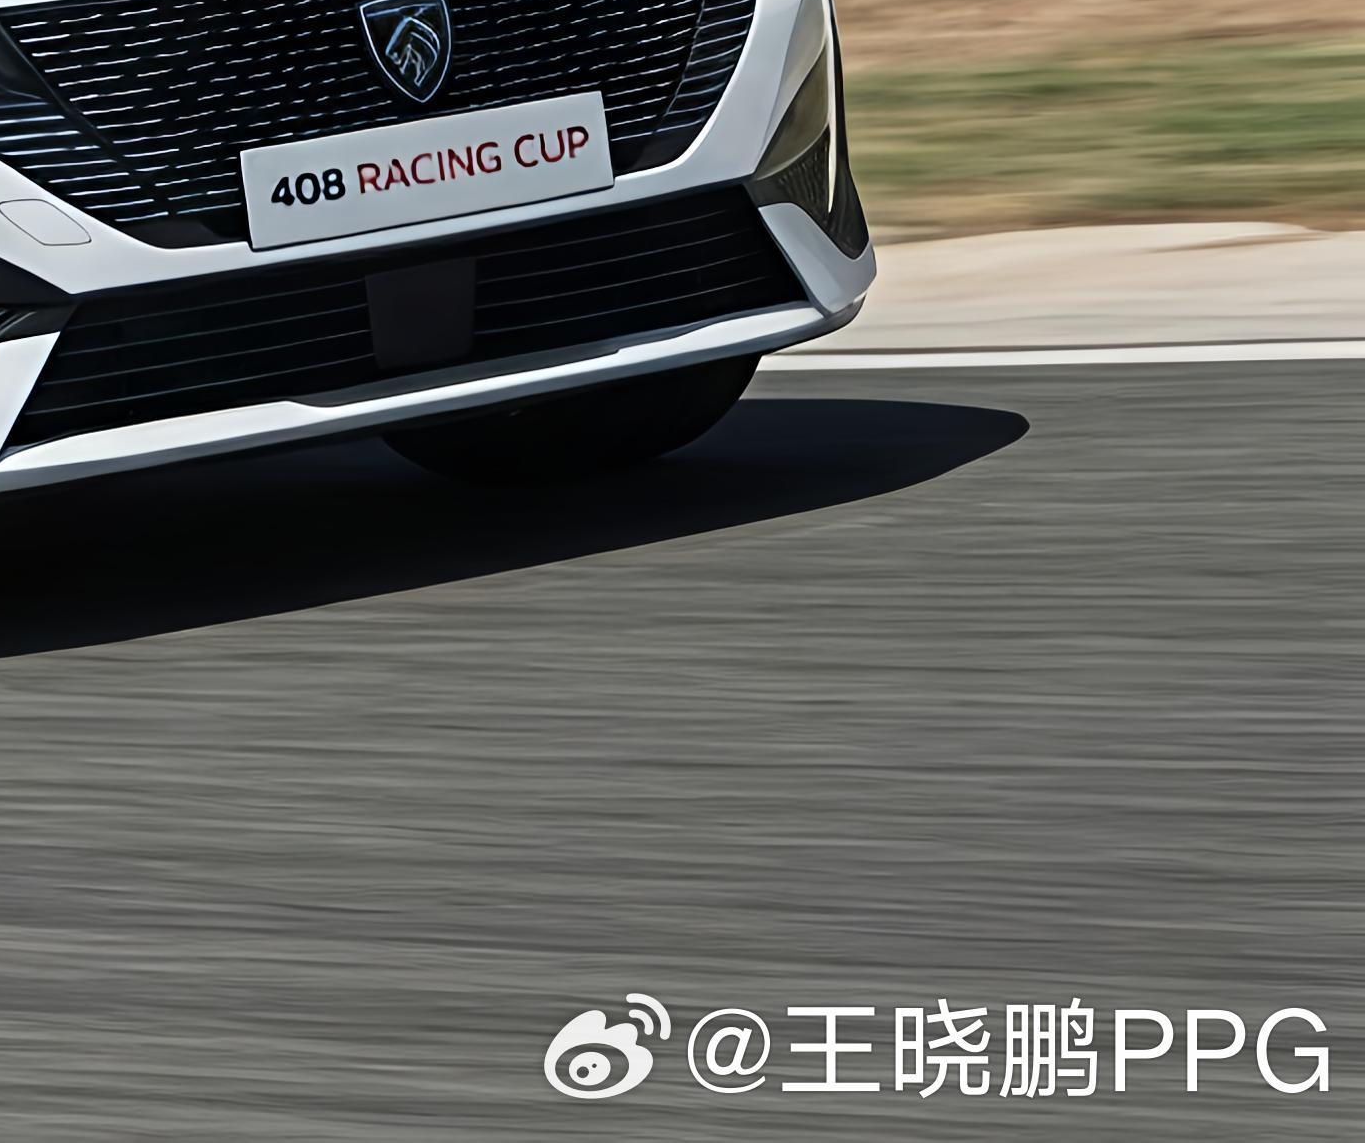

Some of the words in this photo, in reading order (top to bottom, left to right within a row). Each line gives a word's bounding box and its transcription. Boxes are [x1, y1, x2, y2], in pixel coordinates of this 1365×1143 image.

[270, 167, 347, 207] 408
[356, 141, 503, 195] RACING
[513, 125, 590, 168] CUP
